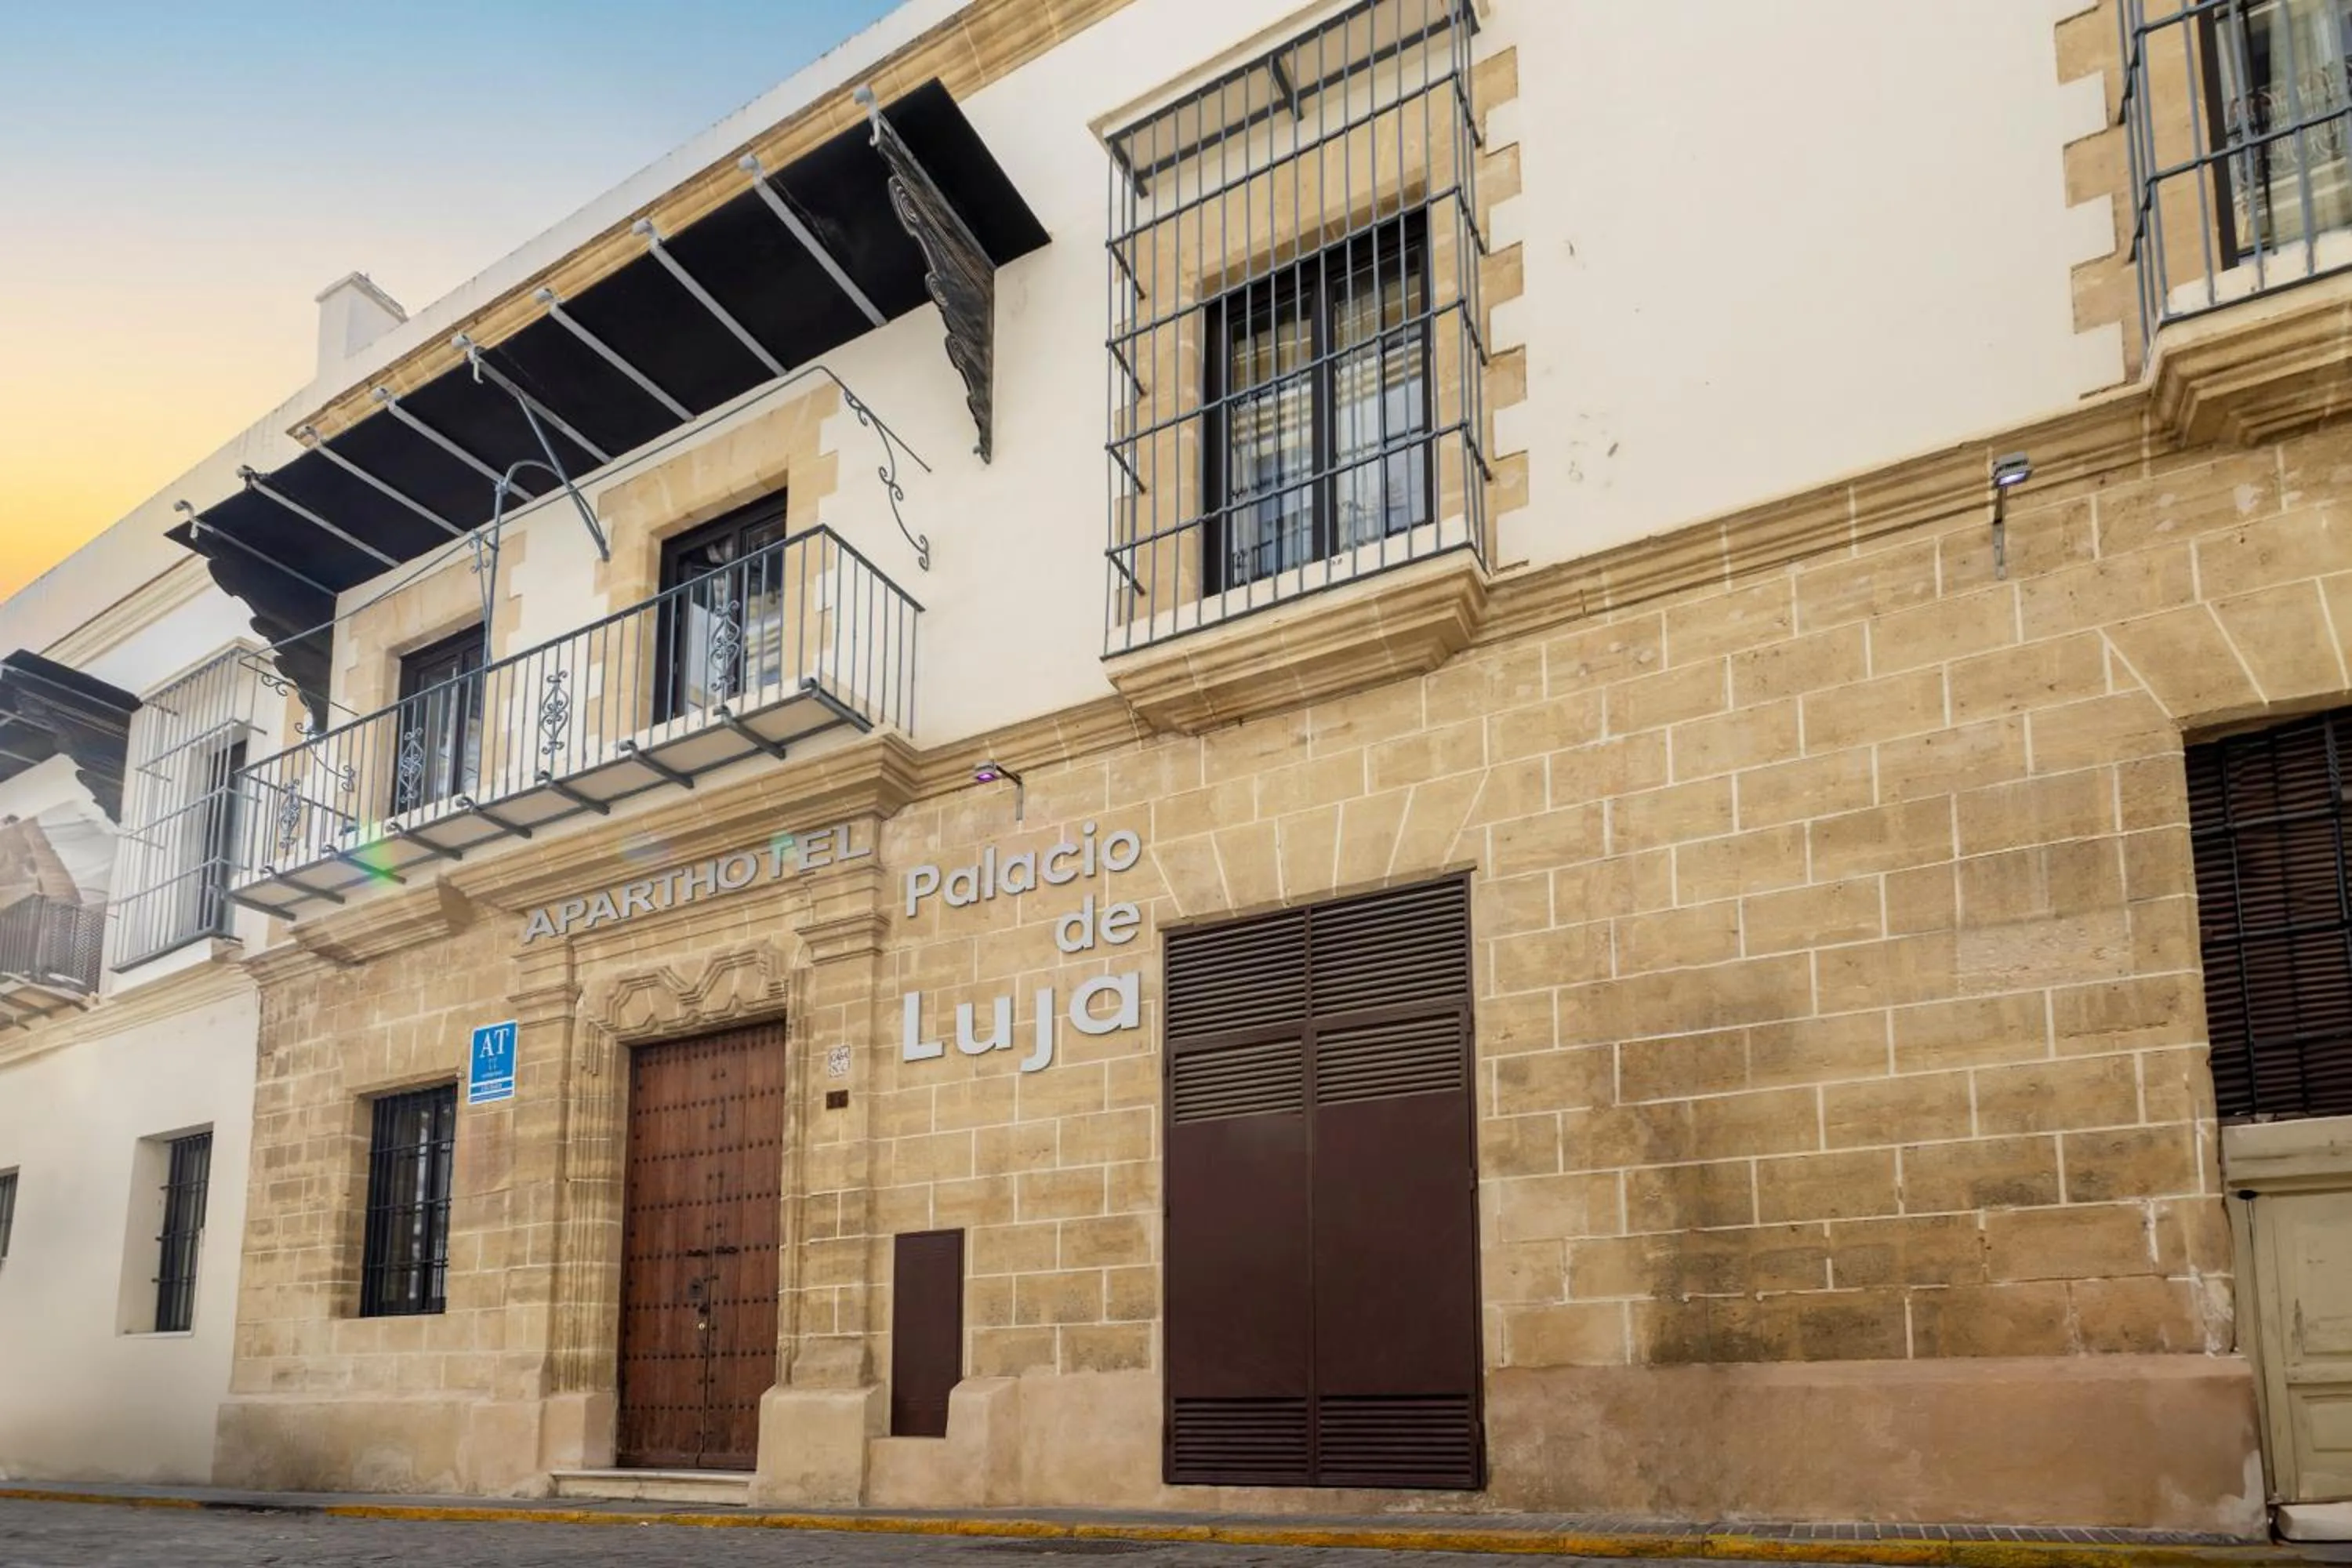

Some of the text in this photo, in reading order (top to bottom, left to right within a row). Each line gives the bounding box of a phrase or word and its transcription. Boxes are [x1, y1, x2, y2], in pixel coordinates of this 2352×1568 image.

[524, 823, 871, 944] APARTHOTEL
[905, 820, 1141, 917] Palacio
[1054, 893, 1142, 953] de
[478, 1028, 510, 1058] AT
[902, 971, 1142, 1073] Luja
